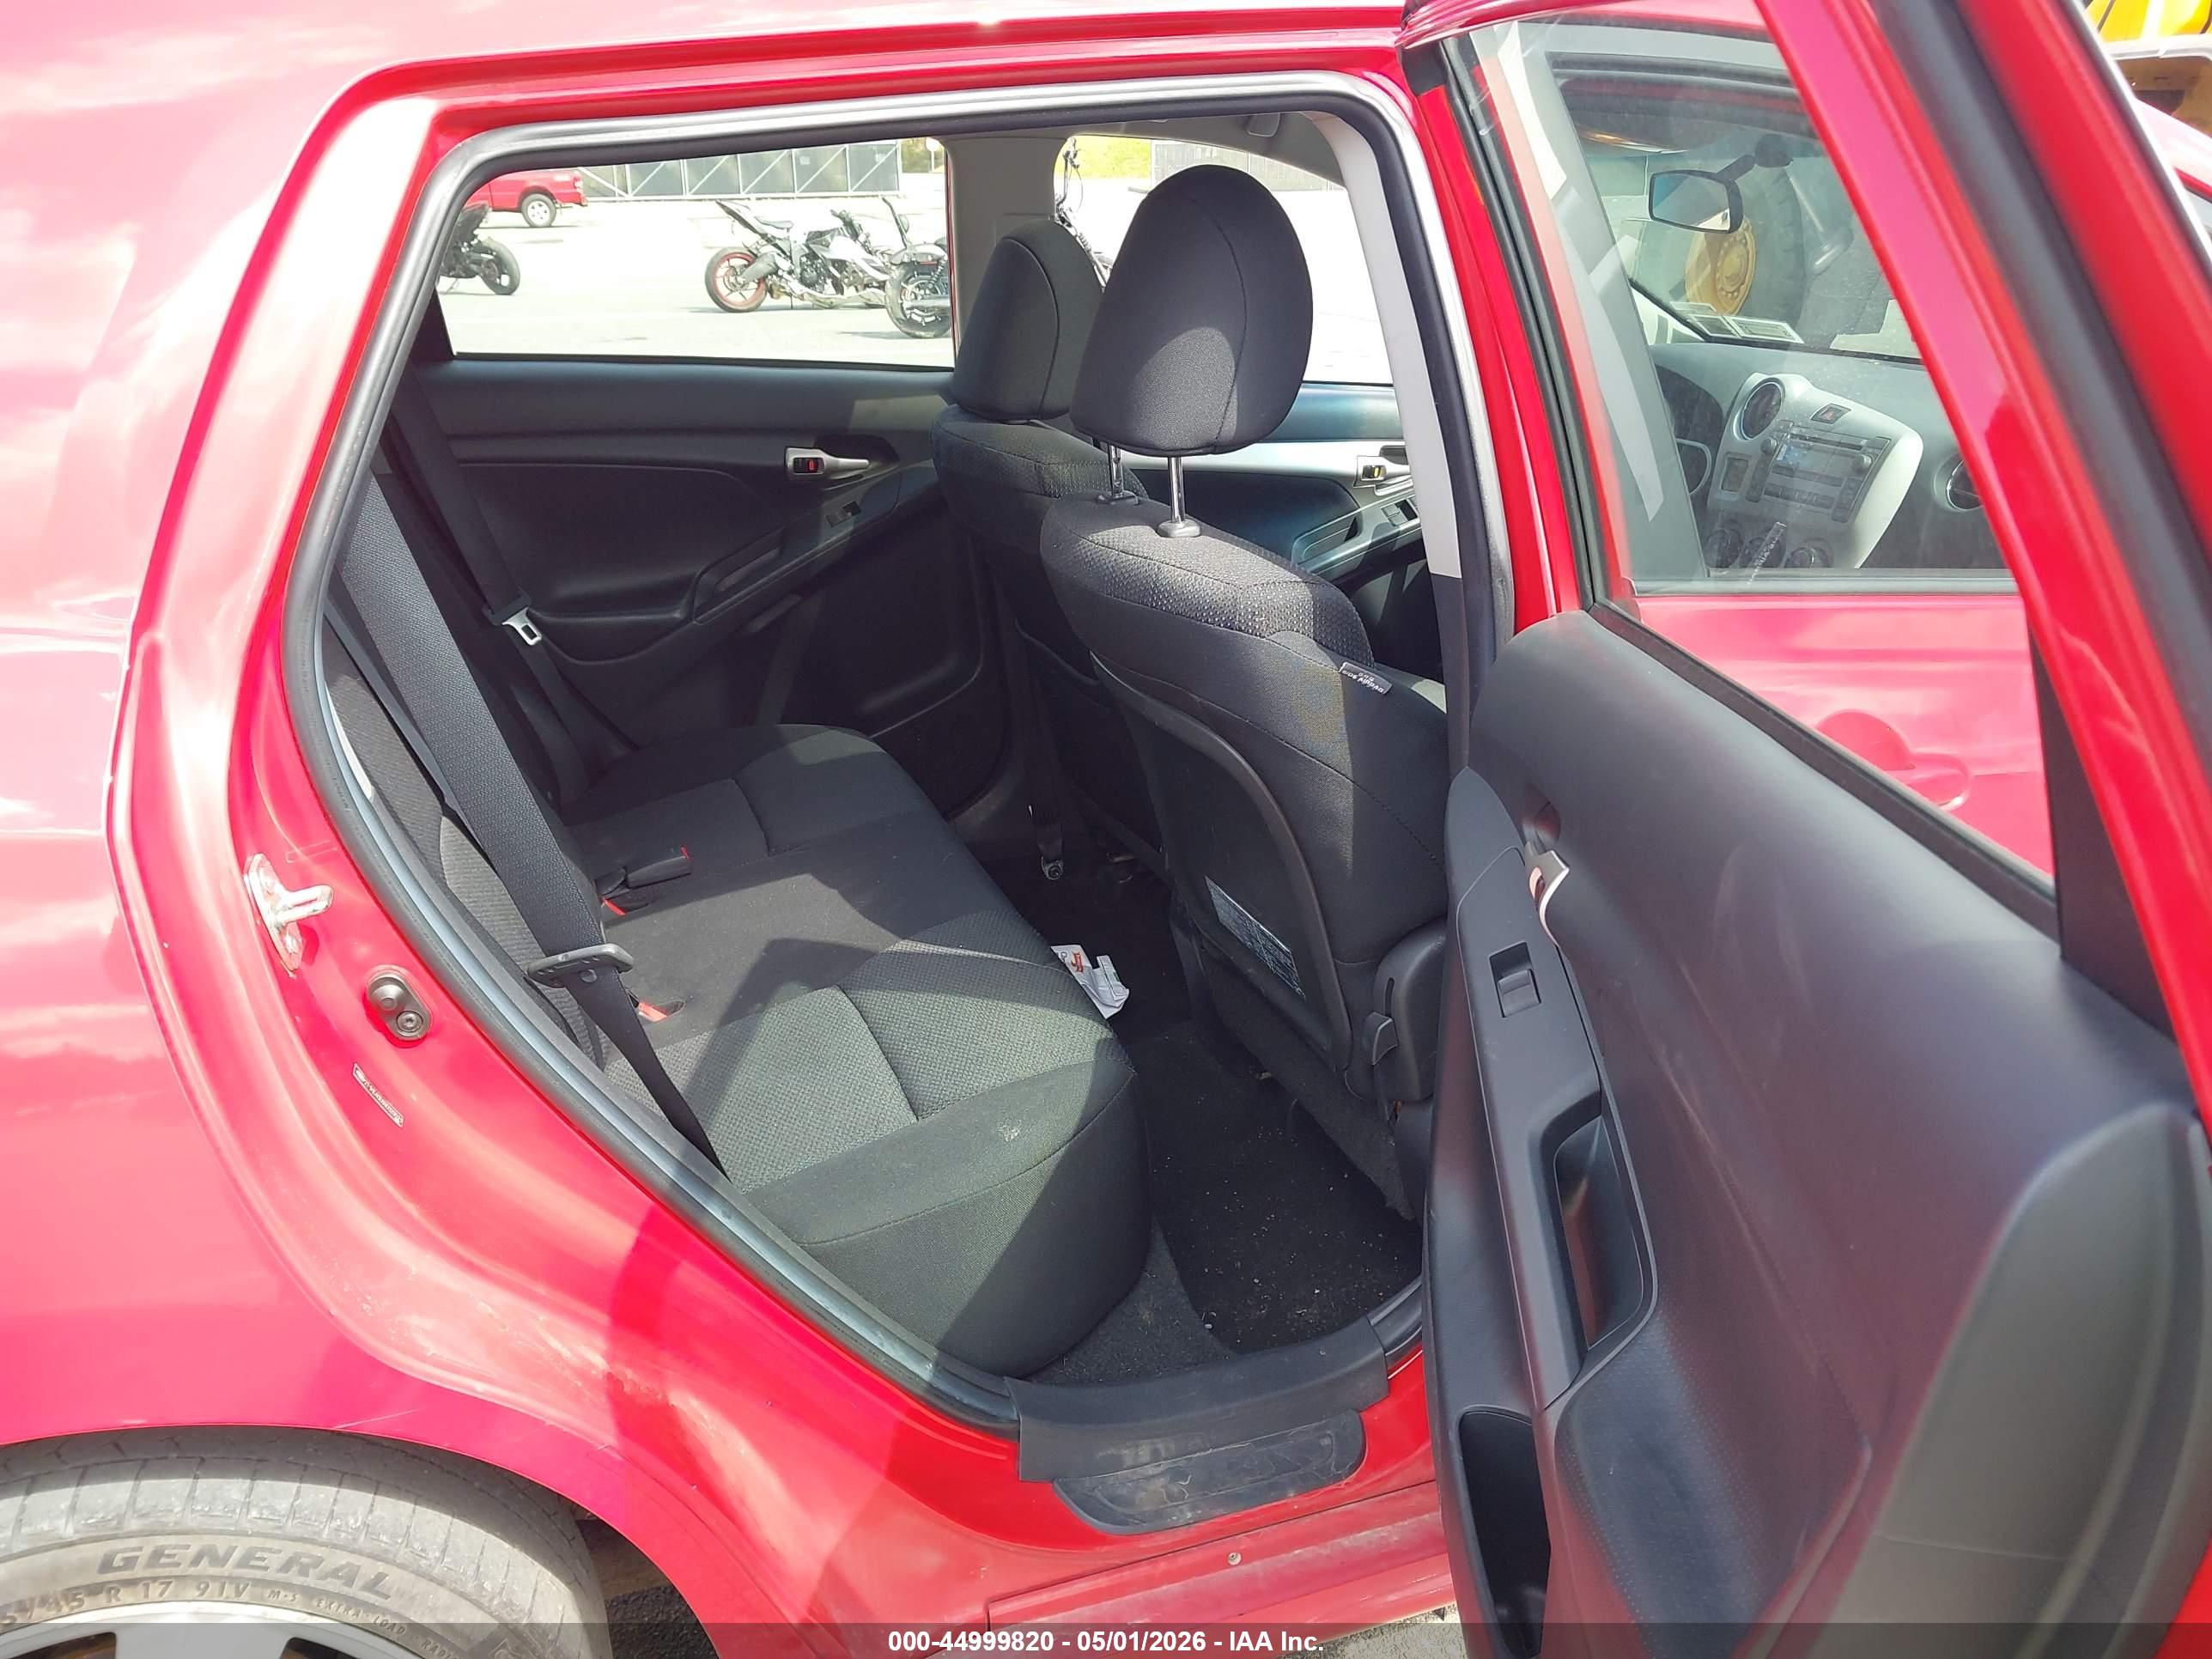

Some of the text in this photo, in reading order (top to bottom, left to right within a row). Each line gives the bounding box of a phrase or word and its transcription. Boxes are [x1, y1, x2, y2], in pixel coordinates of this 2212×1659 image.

[97, 1543, 392, 1601] GENERAL
[104, 1586, 123, 1604] R
[141, 1580, 173, 1600] 17
[195, 1580, 252, 1600] 91V
[315, 1597, 364, 1620] EXTRA
[372, 1614, 407, 1637] LOAD
